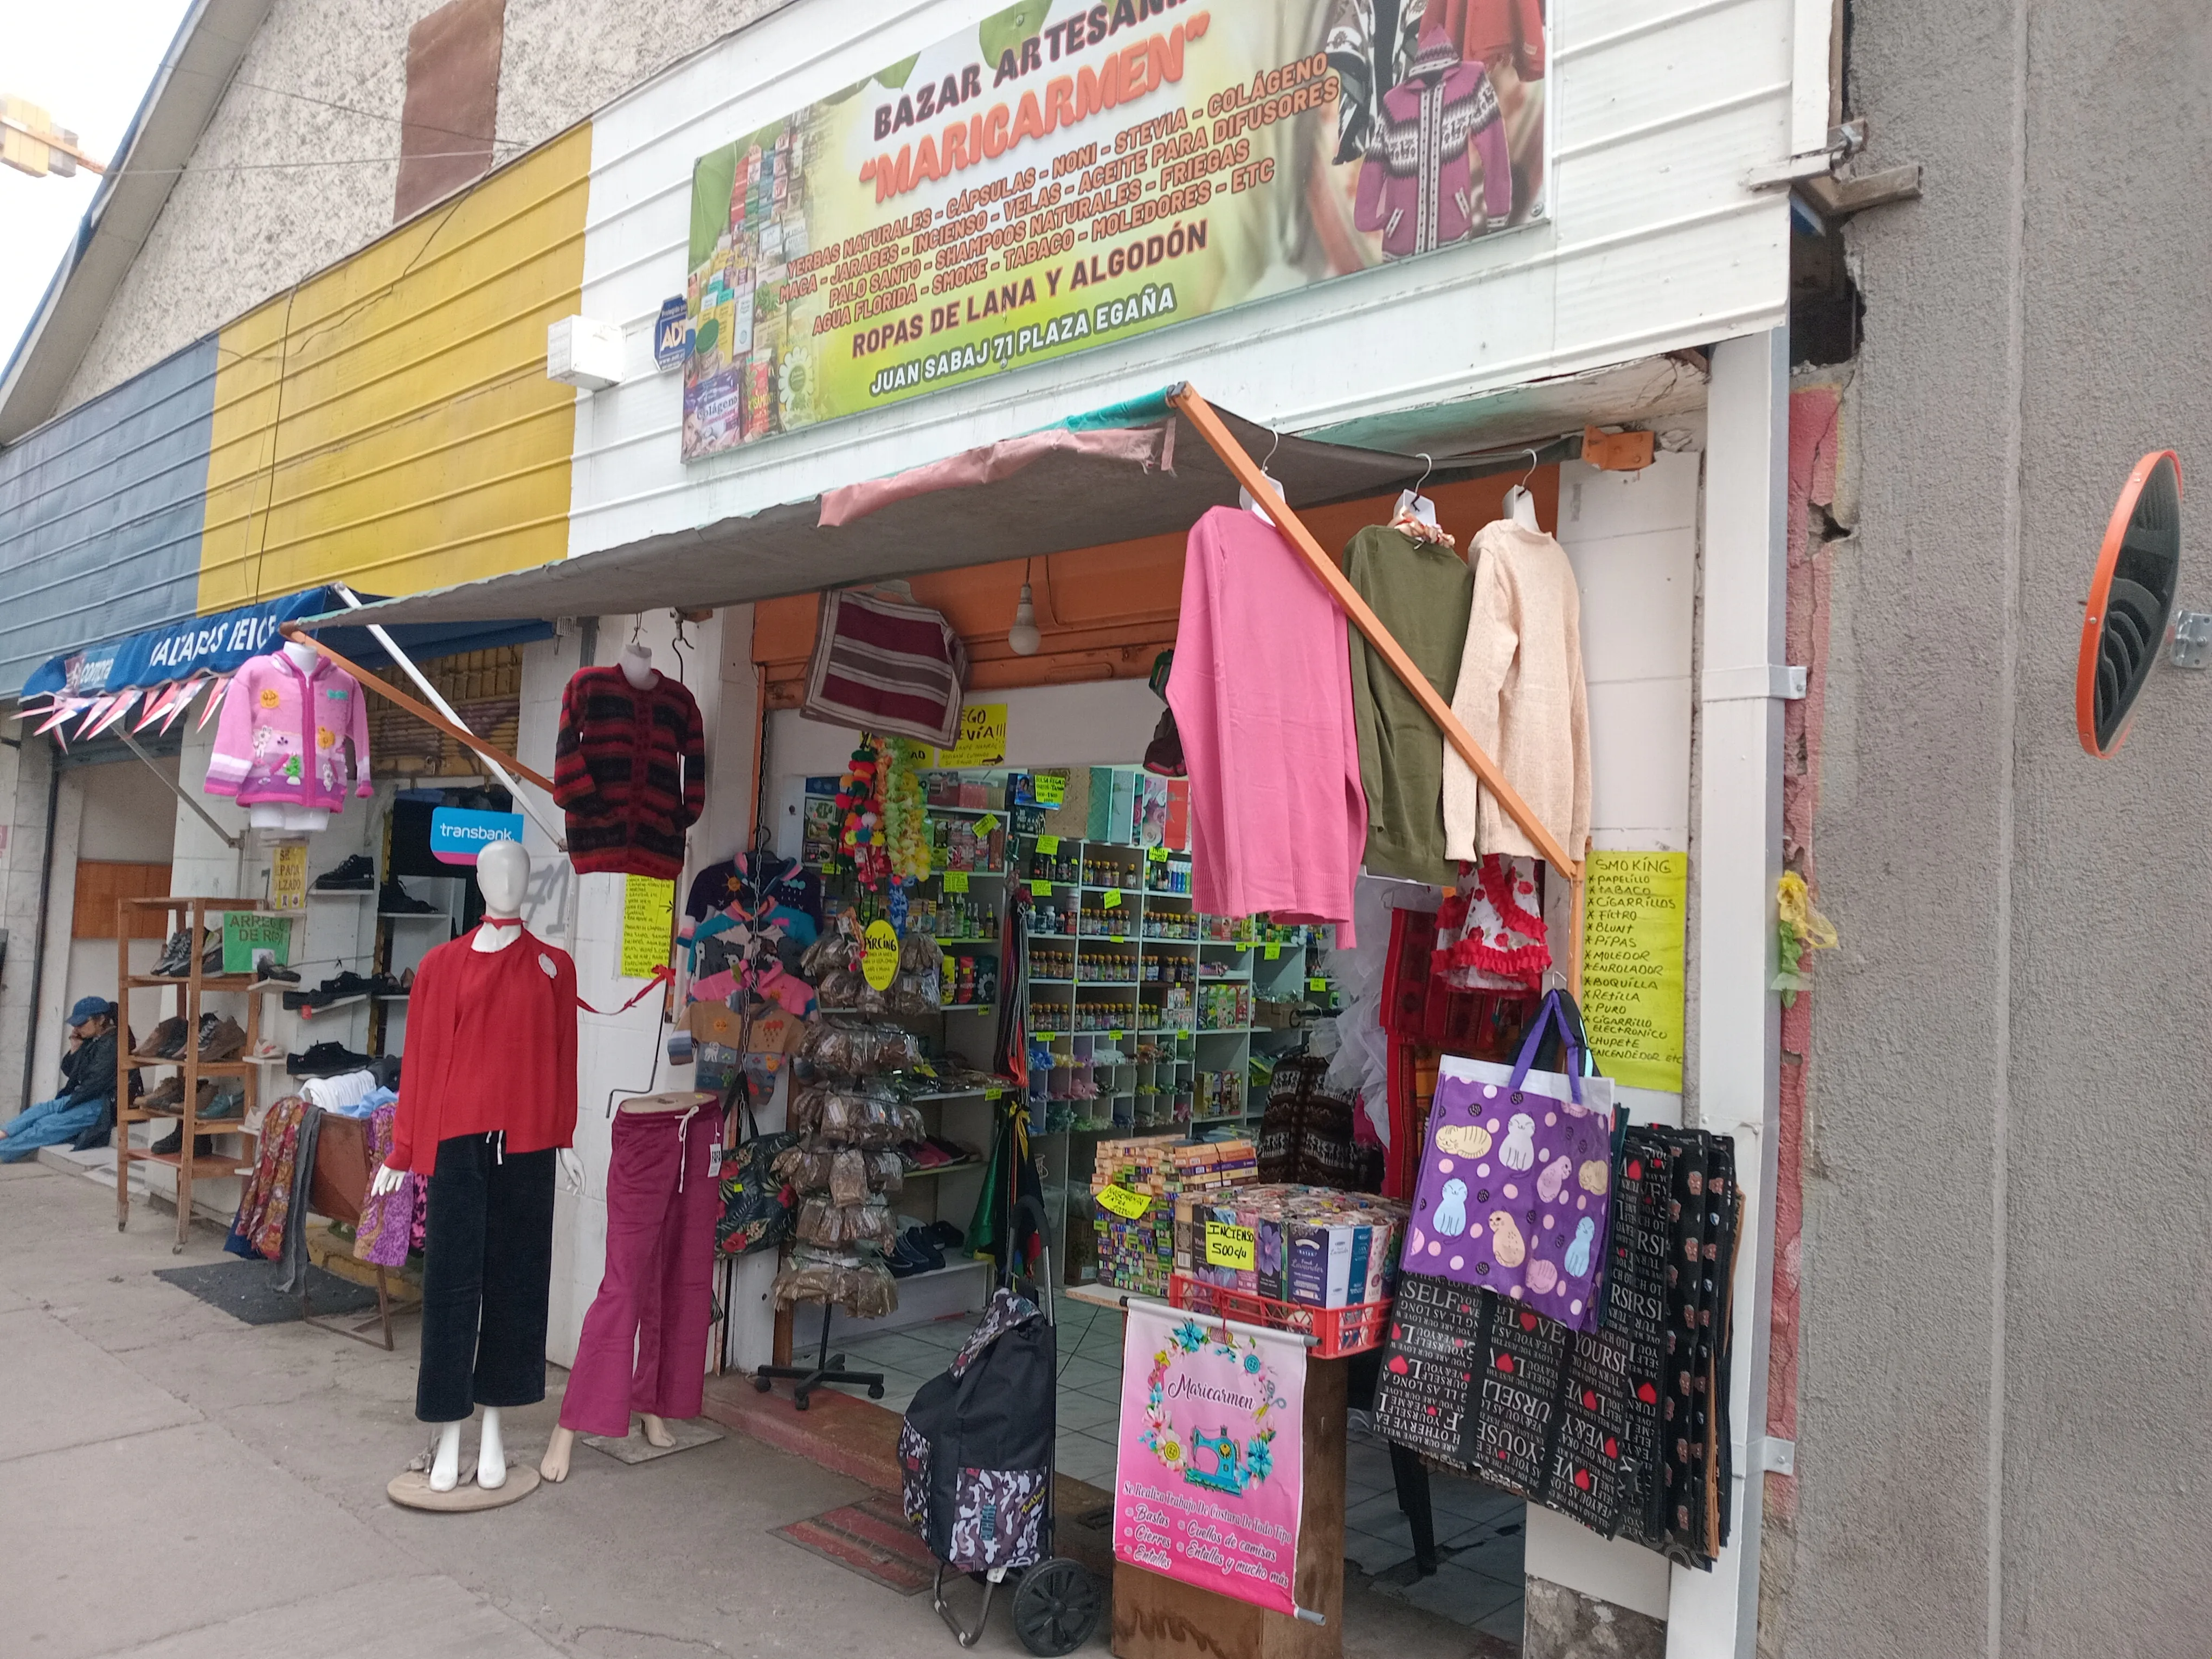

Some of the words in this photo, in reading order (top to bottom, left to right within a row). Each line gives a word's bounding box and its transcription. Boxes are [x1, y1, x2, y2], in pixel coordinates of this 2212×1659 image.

[873, 62, 982, 141] BAZAR
[779, 273, 818, 305] MACA
[830, 243, 899, 286] JARABES
[912, 210, 988, 257] INCIENSO
[1004, 182, 1062, 223] VELAS
[1078, 148, 1148, 196] ACEITE
[1152, 125, 1208, 168] PARA
[1213, 75, 1340, 145] DIFUSORES
[787, 243, 840, 279] YERBAS
[843, 208, 933, 259] NATURALES
[946, 166, 1037, 218] CÁPSULAS
[1052, 142, 1097, 181] NONI
[1114, 107, 1188, 155] STEVIA
[1207, 52, 1328, 119] COLÁGENO
[812, 307, 851, 337] AGUA
[854, 283, 917, 322] FLORIDA
[931, 258, 988, 296] SMOKE
[1004, 228, 1075, 272] TABACO
[1091, 180, 1212, 242] MOLEDORES
[1231, 158, 1275, 195] ETC
[829, 277, 867, 308] PALO
[870, 258, 922, 293] SANTO
[935, 220, 1026, 271] SHAMPOOS
[1030, 178, 1142, 238] NATURALES
[1161, 138, 1250, 192] FRIEGAS
[852, 313, 923, 359] ROPAS
[930, 300, 961, 336] DE
[967, 275, 1037, 324] LANA
[1045, 266, 1063, 298] Y
[1069, 217, 1209, 293] ALGODÓN
[870, 362, 919, 395] JUAN
[924, 341, 989, 380] SABAJ
[993, 333, 1013, 360] 71
[1018, 313, 1089, 353] PLAZA
[1096, 286, 1175, 329] EGAÑA
[239, 929, 259, 942] DE
[1592, 950, 1650, 961] MOLEDOR
[1592, 963, 1664, 976] ENROLADOR
[1595, 1003, 1626, 1015] PURO
[1207, 1225, 1254, 1243] INCIENSO
[1212, 1242, 1233, 1256] 500
[1167, 1372, 1256, 1411] Maricarmen
[1123, 1481, 1135, 1495] Se
[1135, 1482, 1165, 1502] Realiza
[1166, 1491, 1198, 1515] Trabajo
[1210, 1504, 1241, 1525] Costura
[1253, 1518, 1273, 1536] Todo
[1274, 1524, 1292, 1545] Tipo
[1134, 1503, 1169, 1527] Bastas
[1187, 1519, 1221, 1544] Cuellos
[1224, 1533, 1238, 1548] de
[1238, 1540, 1277, 1562] camisas
[1134, 1523, 1171, 1549] Cierres
[1186, 1540, 1224, 1566] Entalles
[1223, 1557, 1235, 1575] y
[1235, 1559, 1268, 1580] mucho
[1269, 1568, 1289, 1588] más
[1134, 1544, 1172, 1570] Entalles
